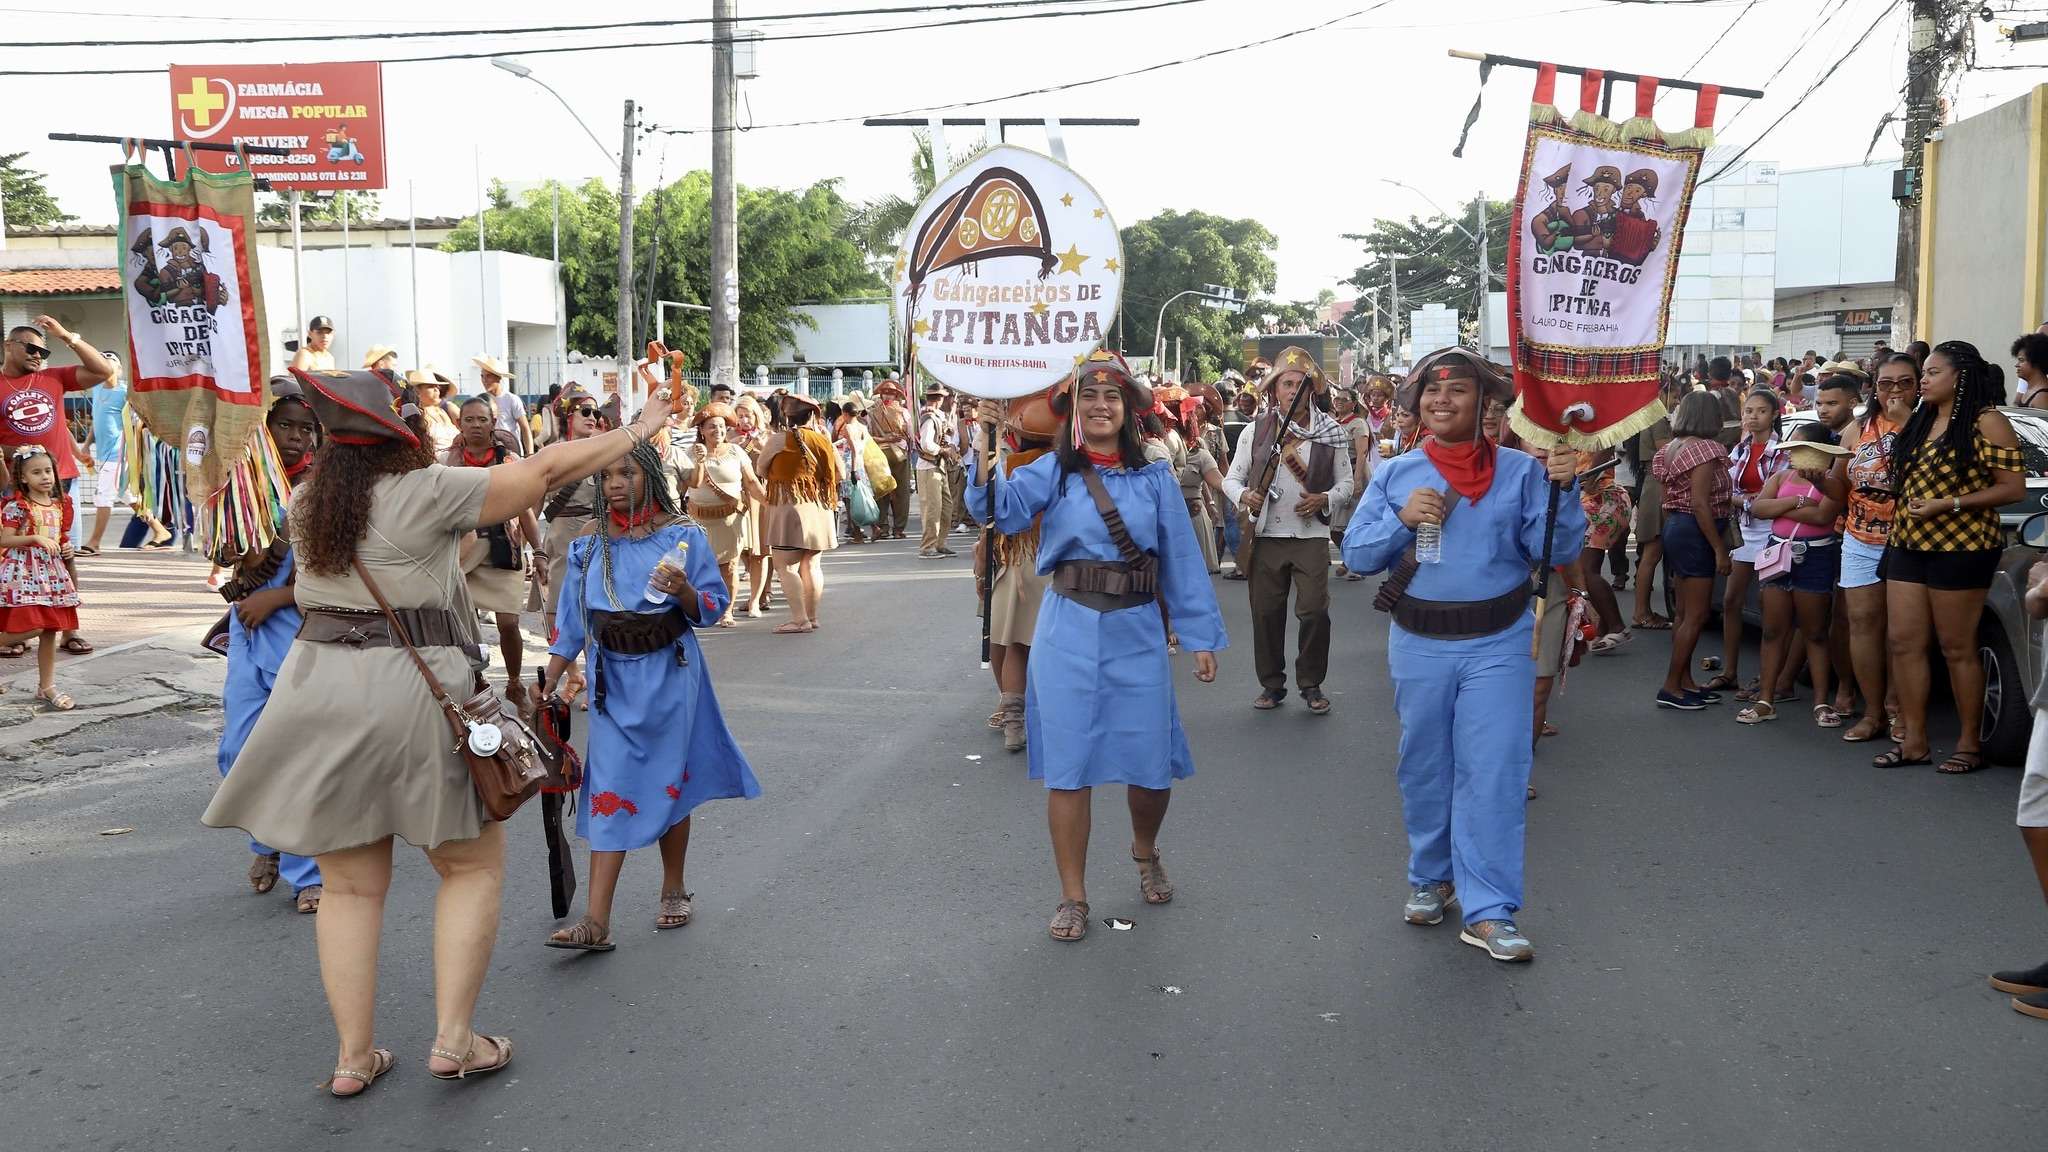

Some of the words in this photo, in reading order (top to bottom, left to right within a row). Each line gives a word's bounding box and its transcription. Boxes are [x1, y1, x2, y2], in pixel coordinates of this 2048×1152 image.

[237, 80, 323, 97] FARMÁCIA
[239, 106, 289, 119] MEGA
[292, 105, 368, 118] POPULAR
[256, 172, 299, 182] DOMINGO
[300, 171, 318, 181] DAS
[319, 171, 337, 181] 07H
[1077, 283, 1102, 302] DE
[1579, 278, 1599, 296] DE
[183, 324, 210, 341] DE
[928, 308, 1103, 347] IPITANGA
[1559, 319, 1574, 331] DE
[945, 353, 972, 366] LAURO
[974, 356, 986, 367] DE
[987, 357, 1048, 370] FREITAS-BAHIA
[10, 392, 43, 405] OAKLEY
